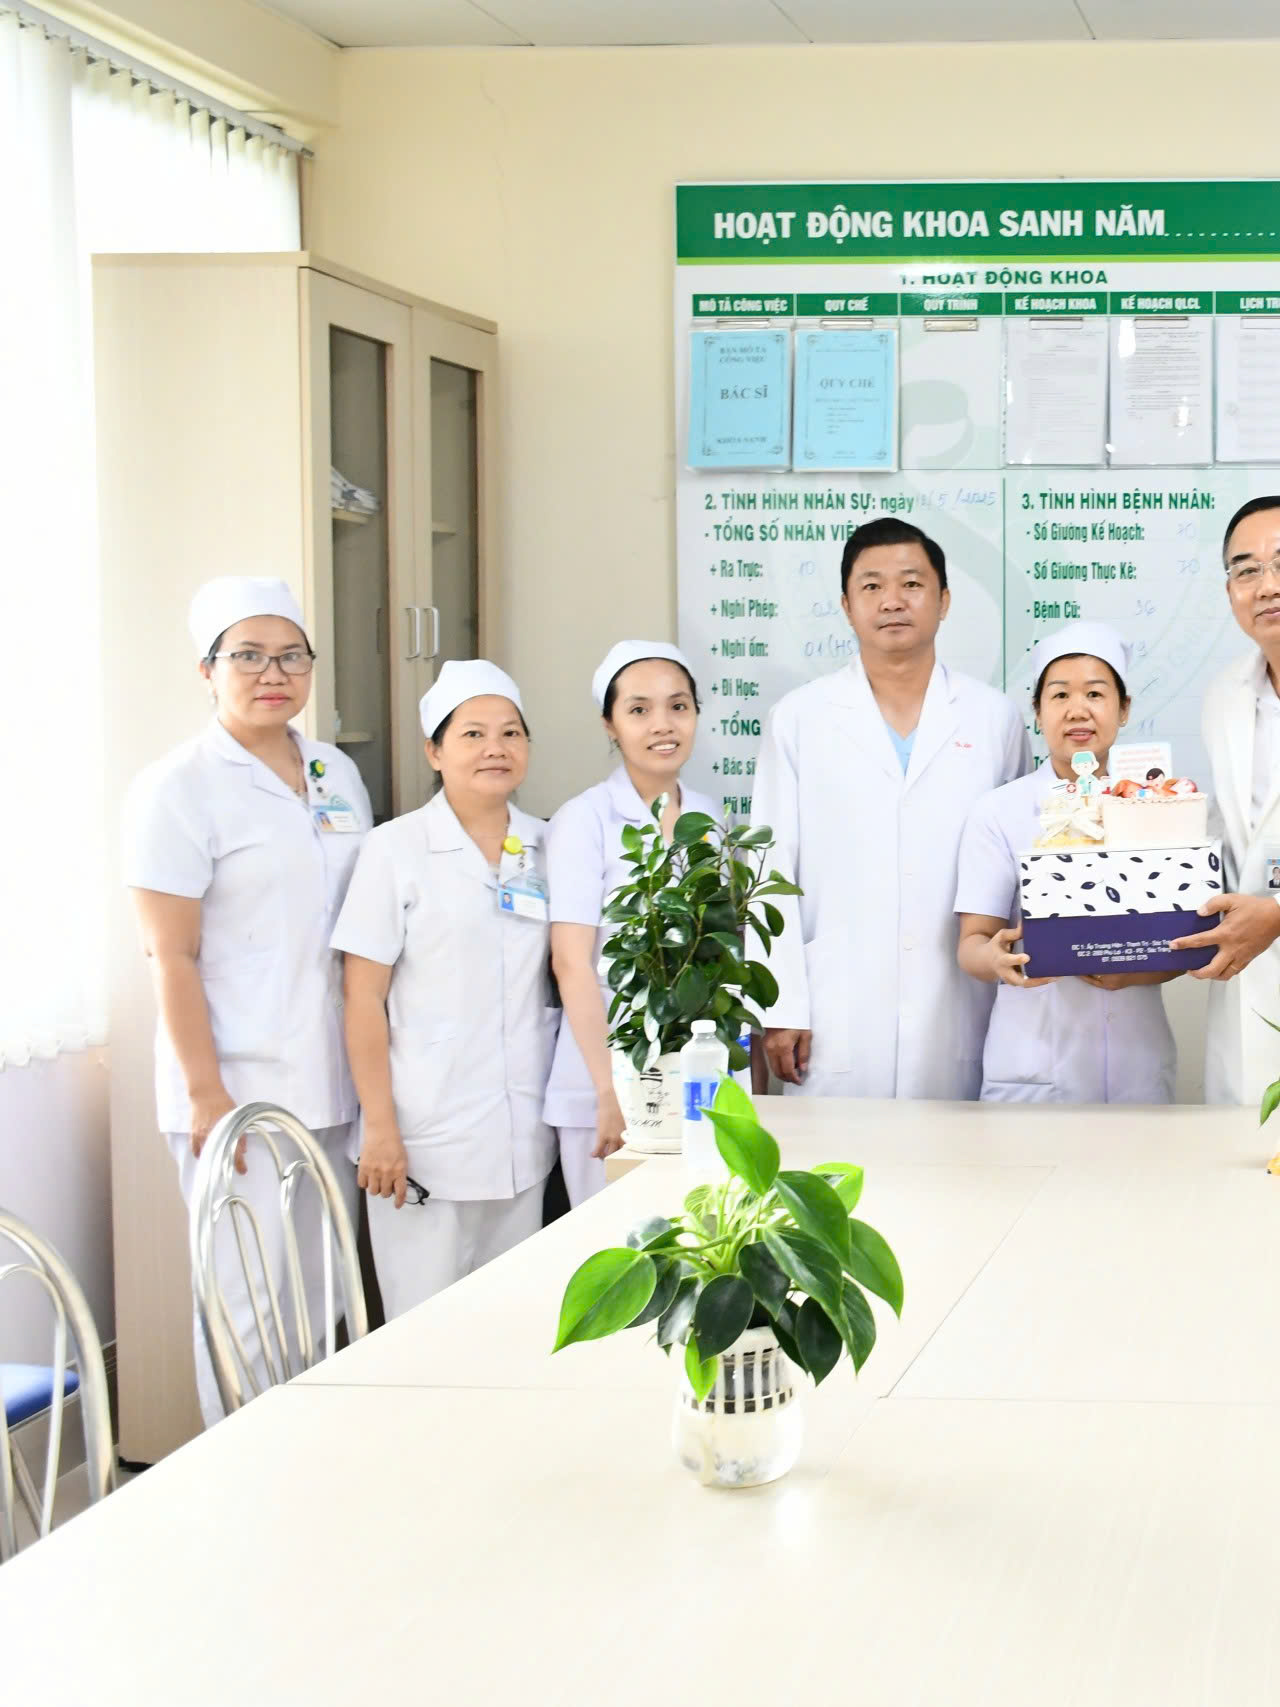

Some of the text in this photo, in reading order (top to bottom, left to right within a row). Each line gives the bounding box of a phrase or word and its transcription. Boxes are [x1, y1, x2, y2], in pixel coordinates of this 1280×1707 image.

[714, 204, 1165, 245] HOẠT ĐỘNG KHOA SANH NĂM
[922, 271, 978, 289] HOẠT
[985, 267, 1042, 289] ĐỘNG
[1050, 270, 1108, 285] KHOA
[698, 298, 717, 312] MÔ
[733, 297, 762, 312] CÔNG
[763, 297, 788, 314] VIỆC
[824, 296, 869, 312] QUY CHẾ
[923, 298, 945, 312] QUY
[1014, 294, 1097, 312] KẾ HOẠCH KHOA
[1120, 294, 1201, 312] KẾ HOẠCH QLCL
[1240, 297, 1265, 311] LỊCH
[720, 384, 751, 400] BÁC
[820, 378, 846, 390] QUY
[704, 489, 914, 515] 2. TÌNH HÌNH NHÂN SỰ: ngày
[1021, 488, 1215, 514] 3. TÌNH HÌNH BỆNH NHÂN:
[713, 517, 858, 541] TỔNG SỐ NHÂN VIÊ
[1033, 519, 1145, 544] Số Giường Kế Hoạch:
[720, 560, 764, 581] Ra Trực:
[1033, 558, 1048, 580] Số
[1051, 561, 1088, 582] Giường
[1091, 561, 1116, 584] Thực
[748, 598, 779, 620] Phép:
[1033, 600, 1060, 622] Bệnh
[721, 678, 760, 700] Đi Học:
[720, 711, 761, 736] TỔNG
[722, 757, 742, 775] Bác
